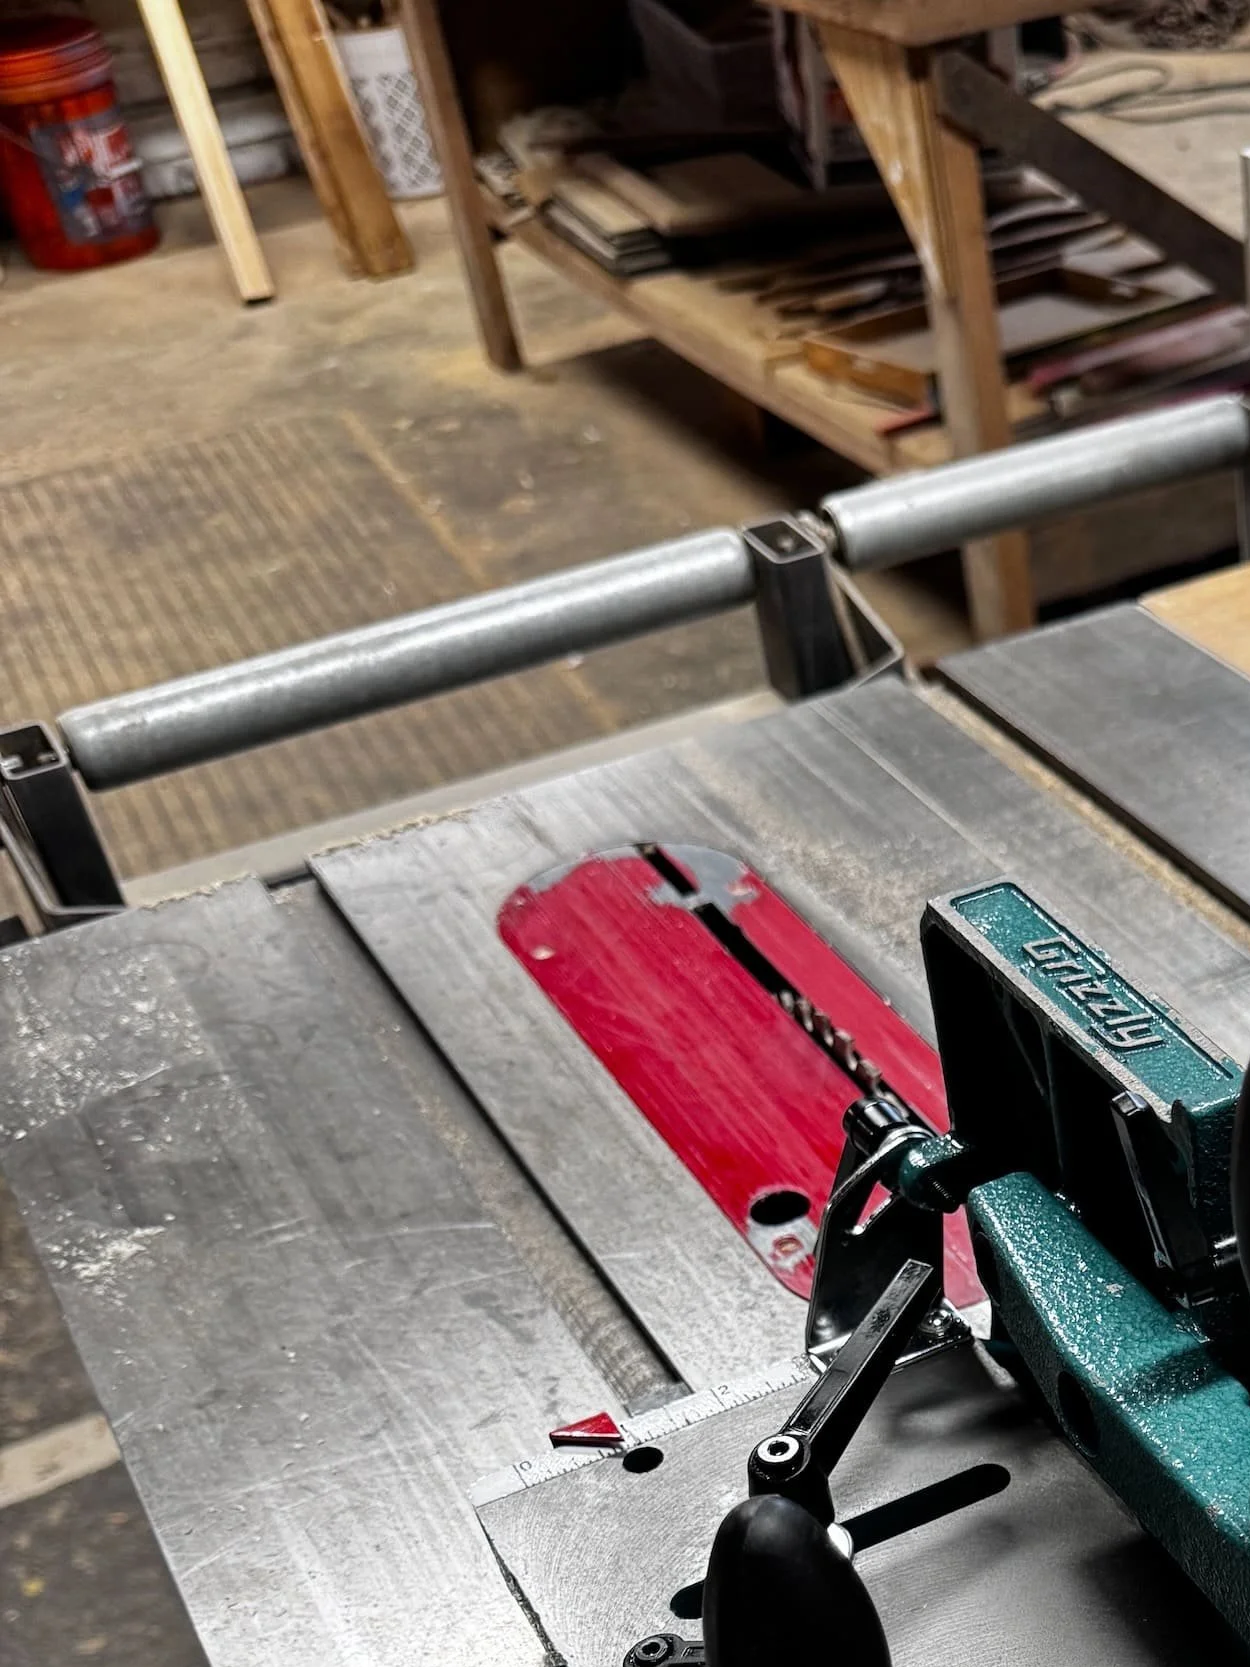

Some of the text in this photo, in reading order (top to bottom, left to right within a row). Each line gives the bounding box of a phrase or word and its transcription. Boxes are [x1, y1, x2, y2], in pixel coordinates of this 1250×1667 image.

[1023, 936, 1163, 1048] Grizzly
[519, 1460, 532, 1472] 0
[717, 1384, 732, 1396] 2
